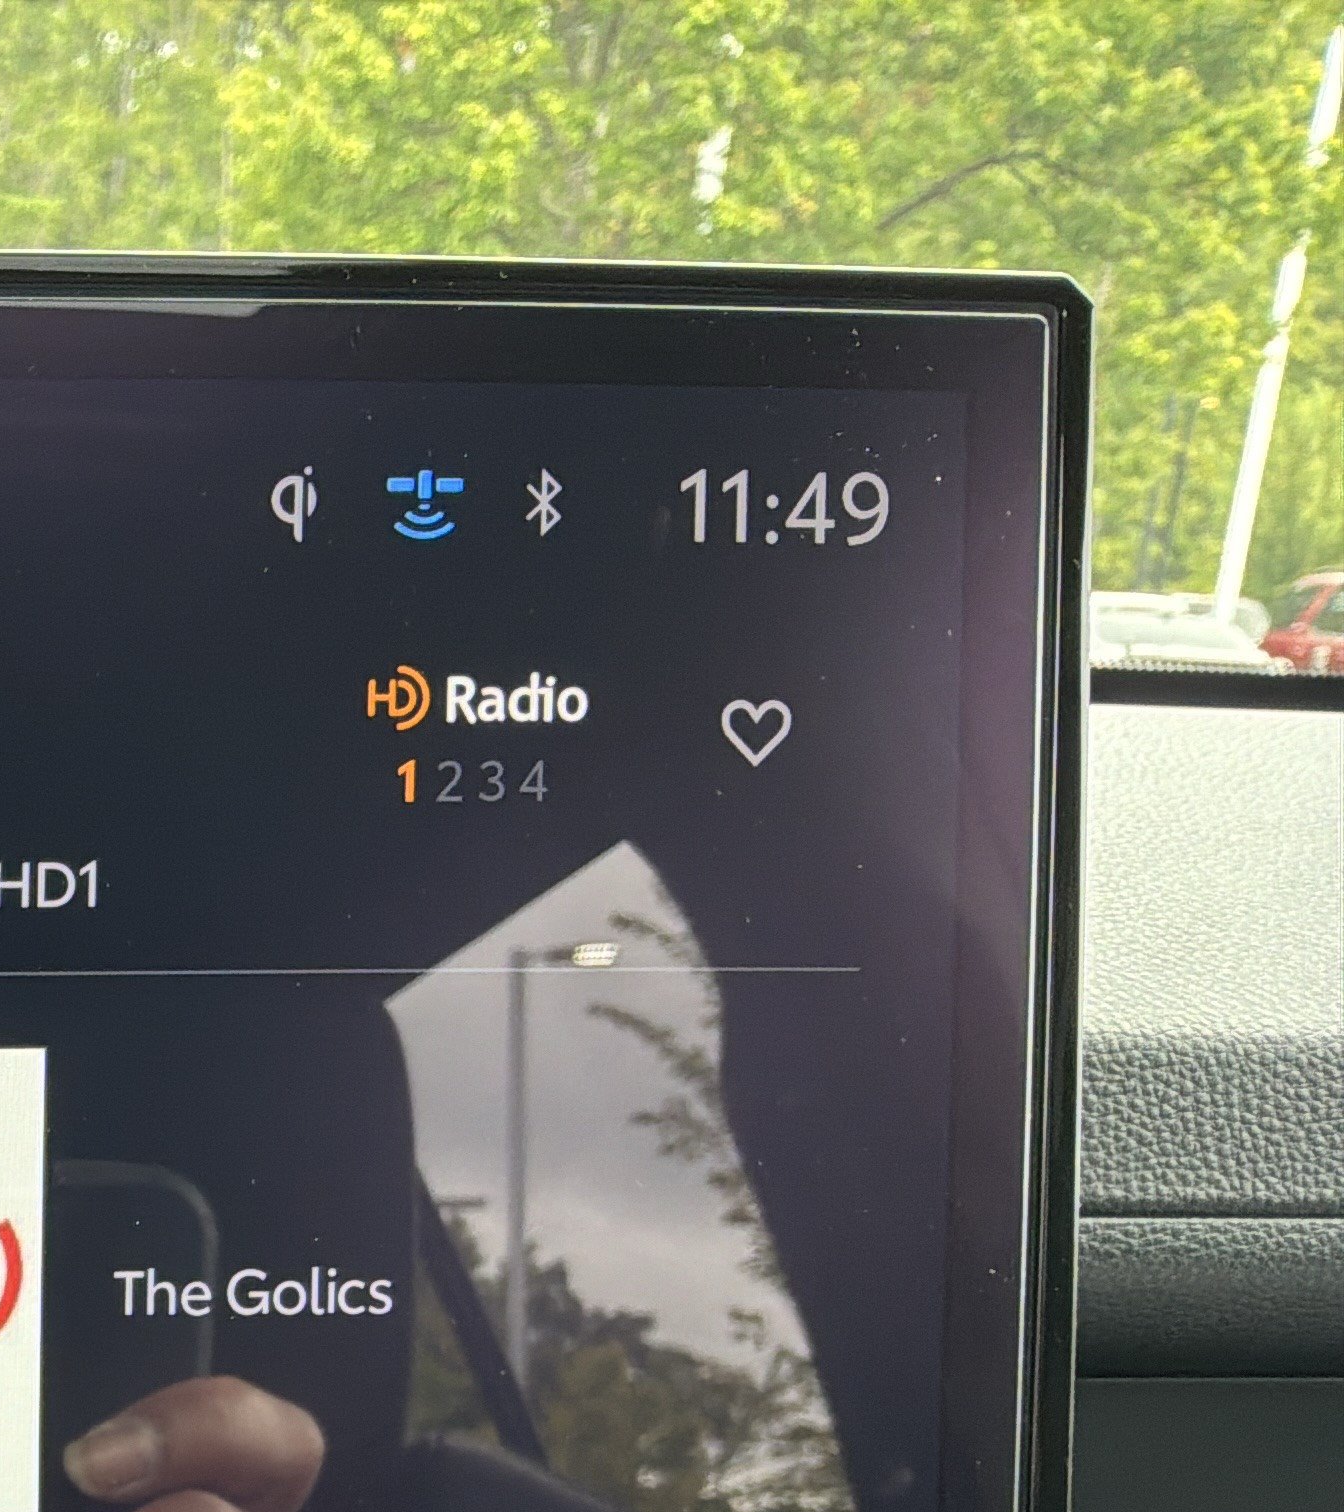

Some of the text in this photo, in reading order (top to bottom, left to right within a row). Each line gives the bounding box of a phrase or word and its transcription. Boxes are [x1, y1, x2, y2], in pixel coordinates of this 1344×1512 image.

[680, 469, 891, 546] 11:49
[445, 671, 589, 725] Radio
[397, 759, 549, 803] 1 2 3 4
[113, 1266, 393, 1317] The Golics
